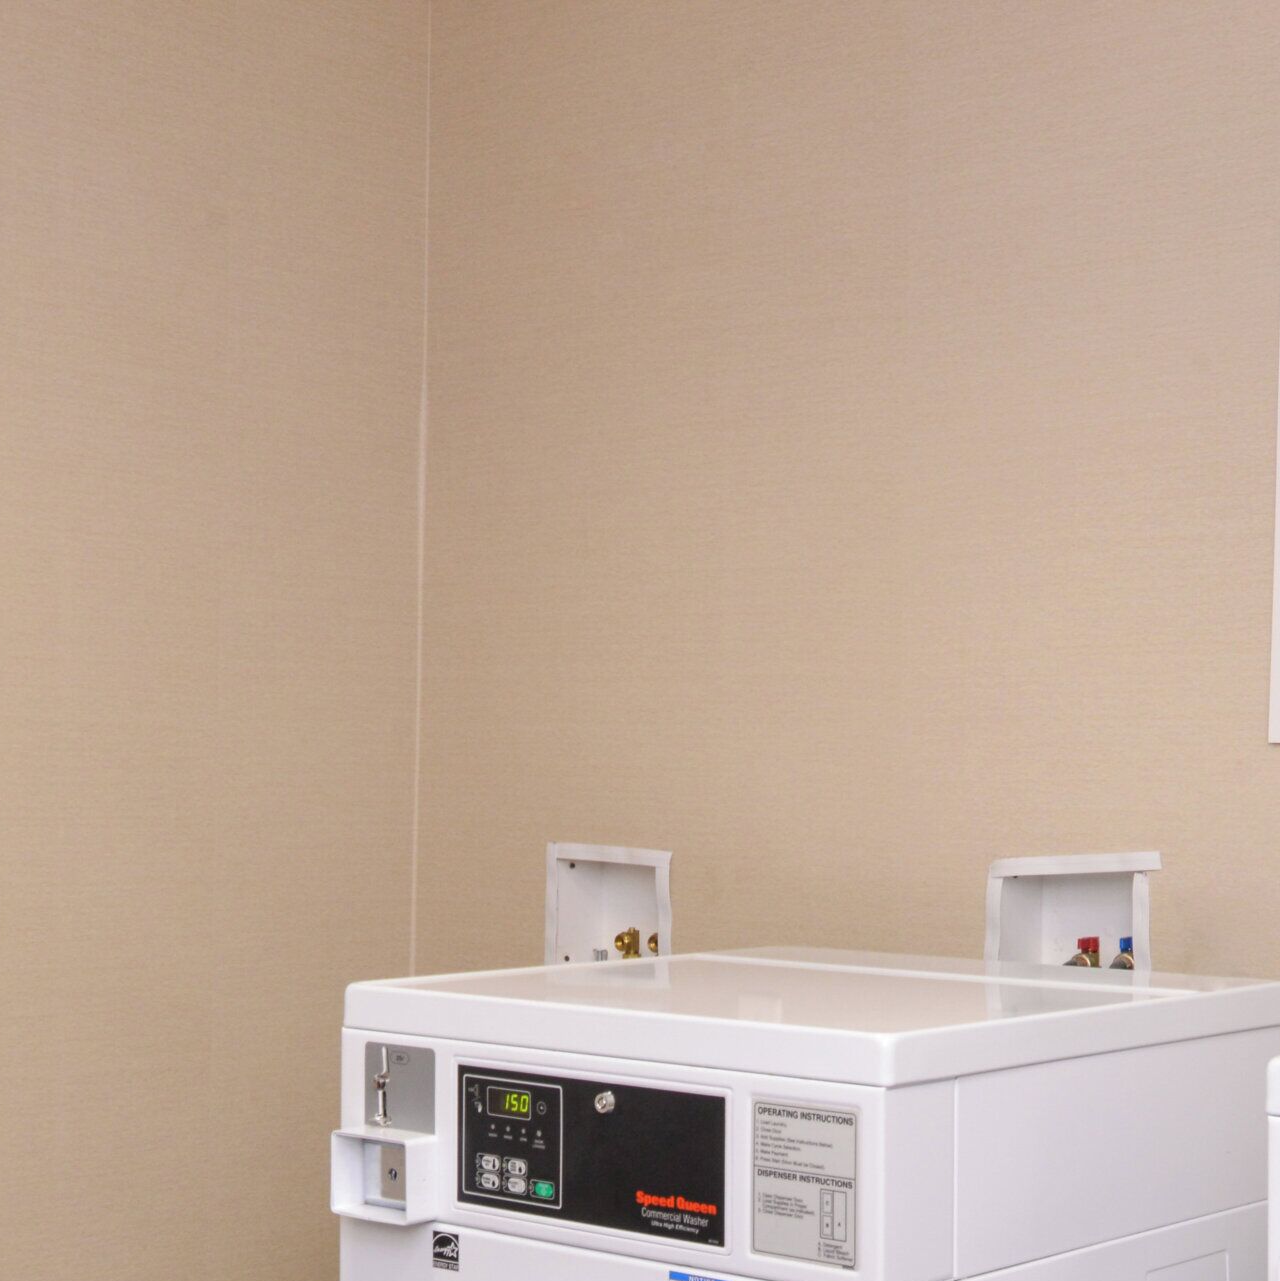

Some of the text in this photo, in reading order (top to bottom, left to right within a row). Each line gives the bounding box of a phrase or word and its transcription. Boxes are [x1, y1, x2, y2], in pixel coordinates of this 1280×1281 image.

[506, 1094, 528, 1112] 150
[758, 1107, 854, 1126] OPERATING INSTRUCTIONS
[758, 1169, 852, 1189] DISPENSER INSTRUCTIONS
[636, 1190, 717, 1216] Speed Queen
[641, 1207, 708, 1227] Commercial Washer
